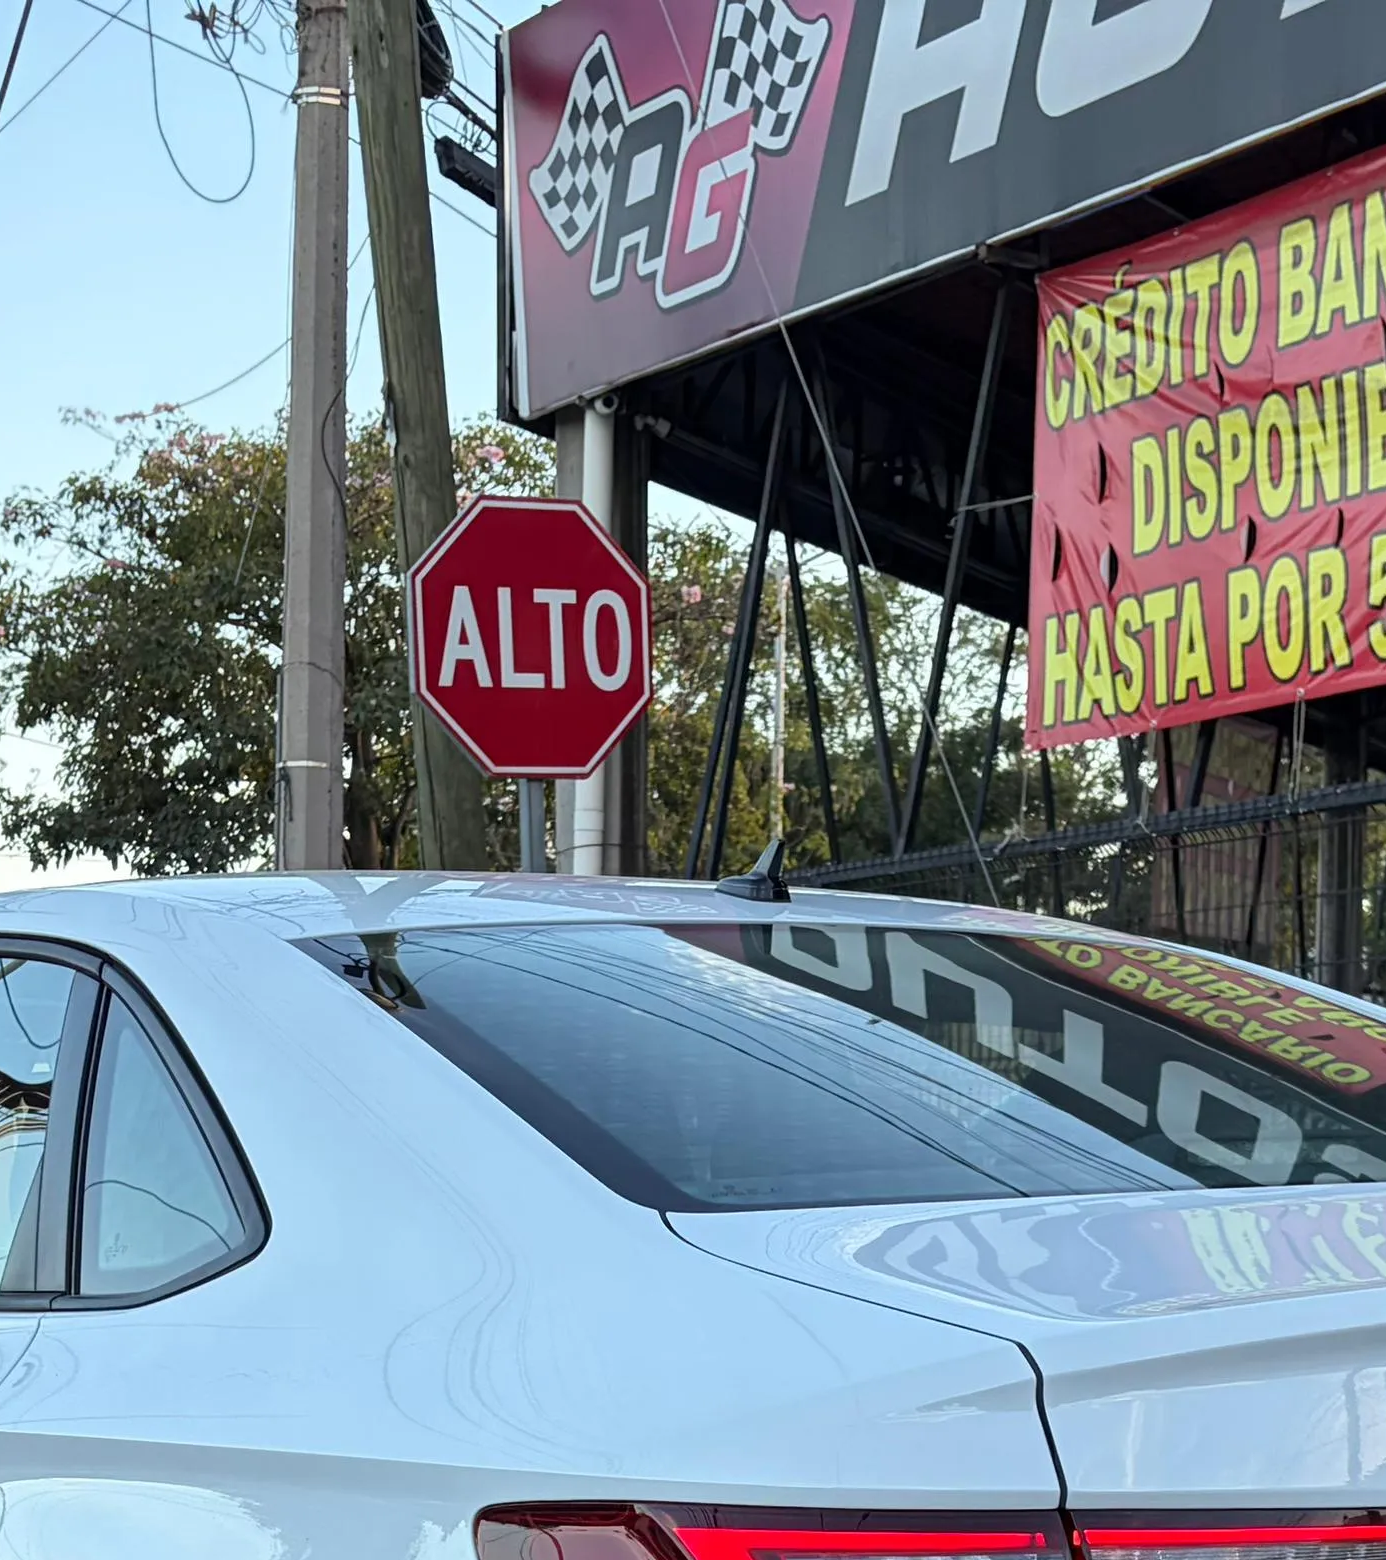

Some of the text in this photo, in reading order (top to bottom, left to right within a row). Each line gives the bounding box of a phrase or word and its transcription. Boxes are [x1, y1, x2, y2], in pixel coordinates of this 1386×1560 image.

[1043, 240, 1261, 431] CRÉDITO
[437, 584, 633, 692] ALTO
[1041, 579, 1216, 729] HASTA
[1226, 543, 1353, 692] POR
